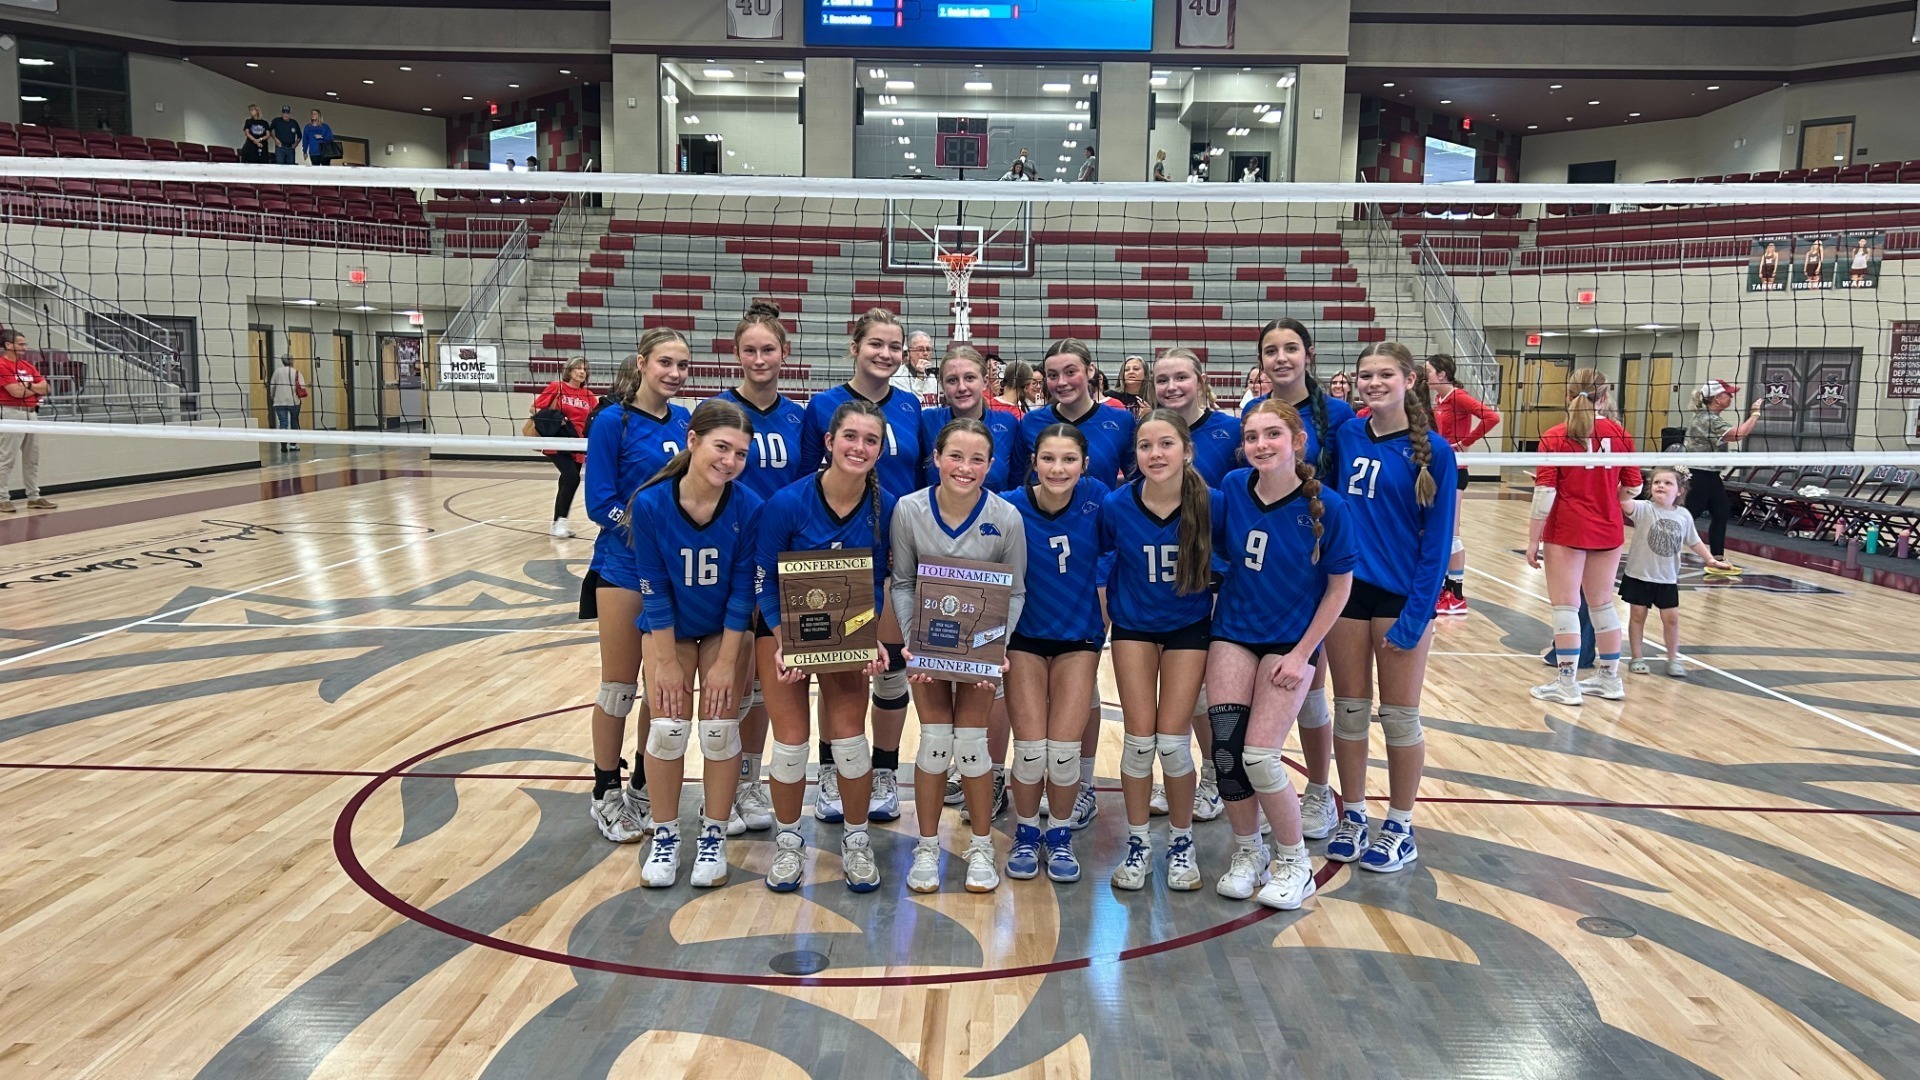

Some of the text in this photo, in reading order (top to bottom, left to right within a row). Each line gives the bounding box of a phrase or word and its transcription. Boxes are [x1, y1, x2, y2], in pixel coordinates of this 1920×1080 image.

[1752, 282, 1783, 291] TANNER
[1842, 280, 1873, 288] WARD
[451, 361, 486, 371] HOME
[443, 371, 495, 380] STUDENT SECTION
[1770, 385, 1784, 393] M
[1824, 386, 1839, 395] M
[753, 432, 788, 469] 10
[1347, 456, 1382, 499] 21
[1874, 465, 1892, 479] M
[1892, 469, 1910, 484] M
[1048, 534, 1071, 574] 7
[1244, 529, 1269, 572] 9
[680, 547, 719, 587] 16
[784, 558, 868, 573] CONFERENCE
[1143, 544, 1180, 583] 15
[920, 565, 1010, 585] TOURNAMENT
[924, 598, 975, 614] 20 25
[794, 649, 869, 665] CHAMPIONS
[918, 657, 992, 674] RUNNER-UP
